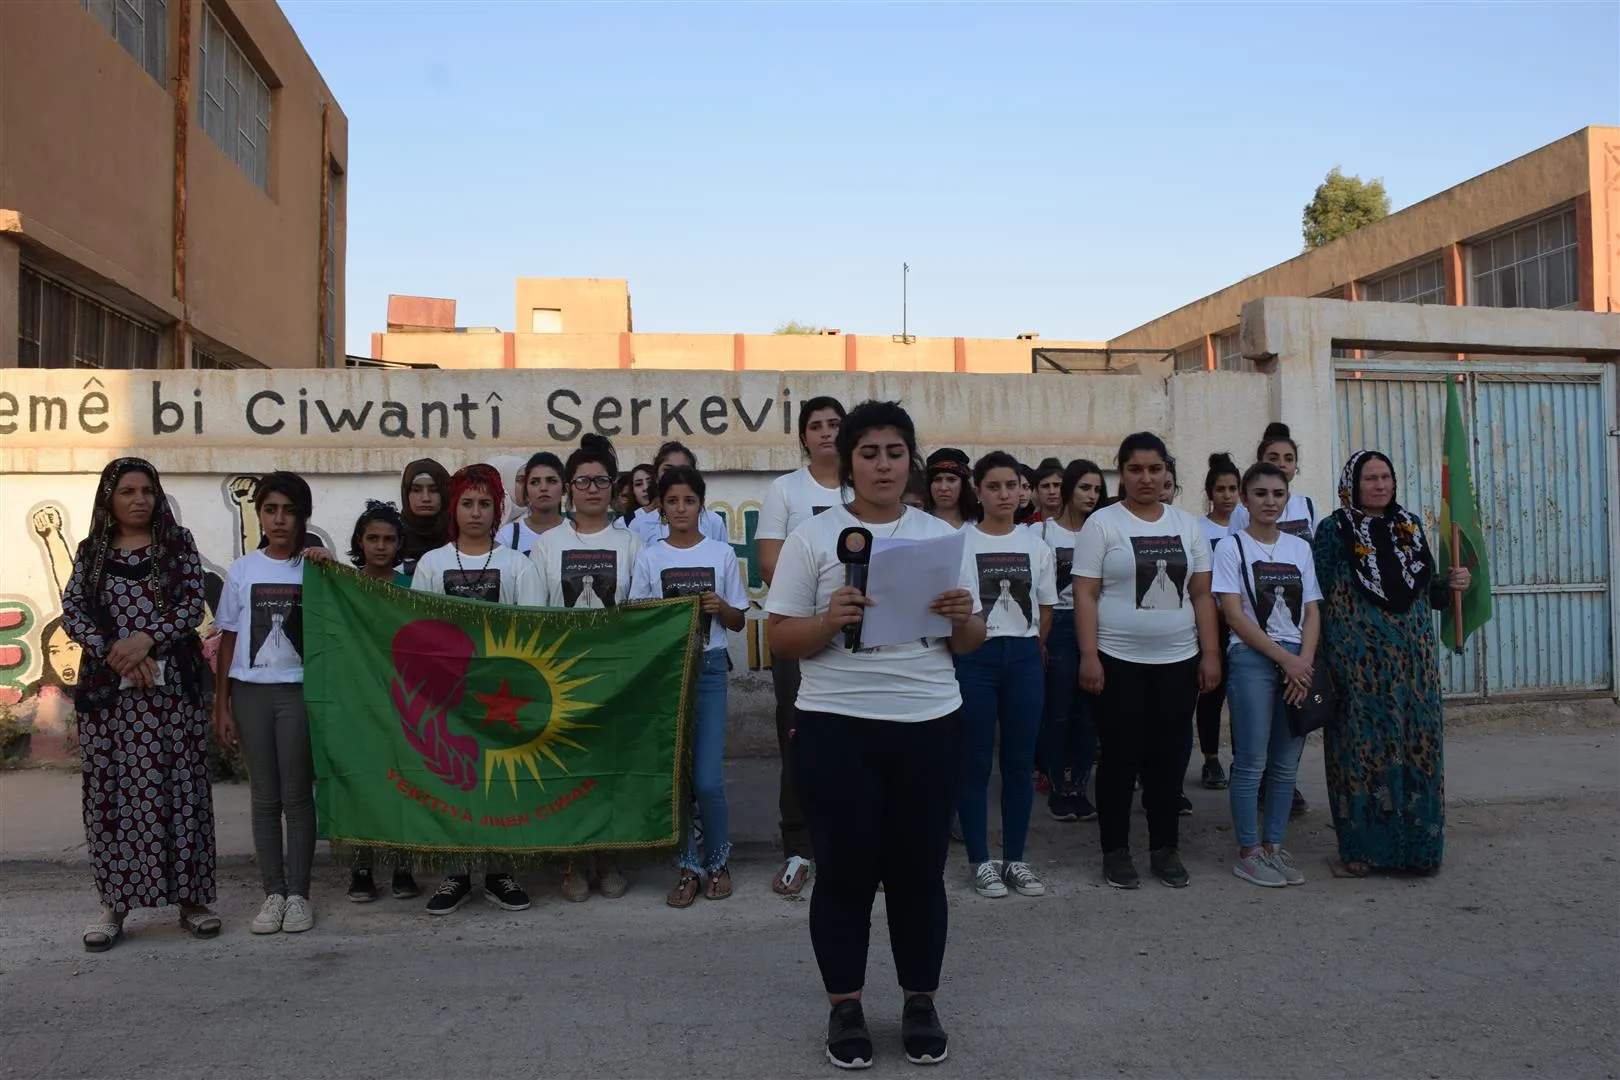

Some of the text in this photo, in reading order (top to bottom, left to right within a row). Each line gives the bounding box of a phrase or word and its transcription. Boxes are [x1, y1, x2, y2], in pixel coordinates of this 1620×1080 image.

[152, 380, 204, 435] bi
[245, 387, 503, 439] Ciwantî
[546, 388, 808, 442] Serkevi
